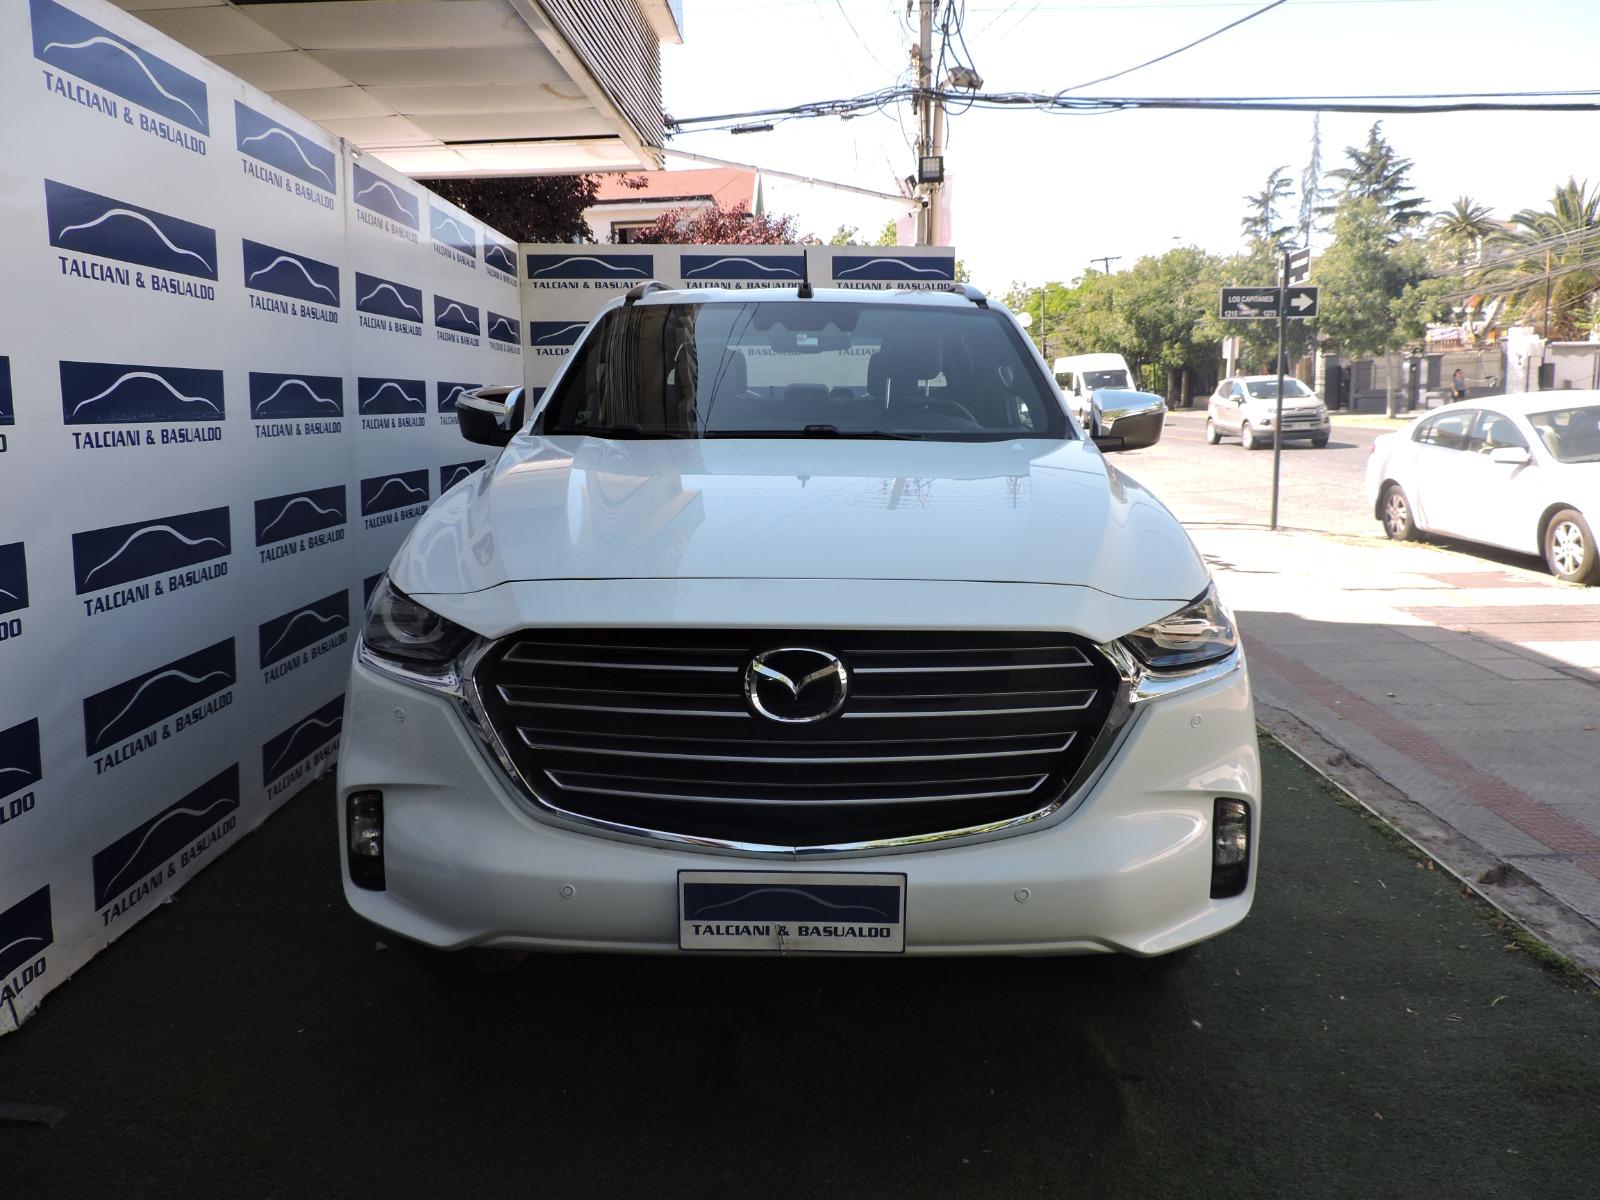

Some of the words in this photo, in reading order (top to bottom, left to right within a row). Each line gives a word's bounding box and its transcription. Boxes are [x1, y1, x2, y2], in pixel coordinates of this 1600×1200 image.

[43, 70, 117, 119] TALCIANI
[124, 107, 133, 126] &
[140, 114, 206, 156] BASUALDO
[241, 159, 282, 189] TALCIANI
[286, 179, 292, 192] &
[295, 184, 334, 210] BASUALDO
[59, 256, 130, 286] TALCIANI
[136, 272, 145, 289] &
[152, 276, 214, 301] BASUALDO
[533, 281, 579, 289] TALCIANI
[837, 282, 882, 290] TALCIANI
[886, 282, 892, 290] &
[249, 295, 288, 315] TALCIANI
[292, 304, 297, 316] &
[301, 306, 338, 323] BASUALDO
[1228, 295, 1241, 303] LOS
[359, 316, 386, 331] TALCIANI
[536, 348, 570, 356] TALCIA
[255, 424, 293, 438] TALCIANI
[296, 424, 302, 435] &
[305, 422, 341, 434] BASUALDO
[362, 418, 389, 430] TALCIANI
[398, 417, 425, 427] BASUALDO
[72, 430, 140, 449] TALCIANI
[146, 428, 155, 445] &
[161, 427, 222, 443] BASUALDO
[364, 513, 392, 530] TALCIANI
[259, 543, 297, 564] TALCIANI
[300, 539, 305, 551] &
[308, 528, 344, 547] BASUALDO
[84, 583, 149, 616] TALCIANI
[154, 578, 163, 596] &
[168, 562, 228, 592] BASUALDO
[264, 656, 300, 684] TALCIANI
[303, 651, 308, 664] &
[312, 631, 347, 660] BASUALDO
[94, 730, 157, 775] TALCIANI
[162, 724, 171, 740] &
[176, 691, 232, 732] BASUALDO
[267, 767, 302, 800] TALCIANI
[305, 760, 311, 772] &
[102, 871, 163, 926] TALCIANI
[168, 862, 176, 877] &
[181, 816, 236, 868] BASUALDO
[692, 924, 770, 936] TALCIANI
[778, 926, 789, 936] &
[798, 926, 891, 938] BASUALDO
